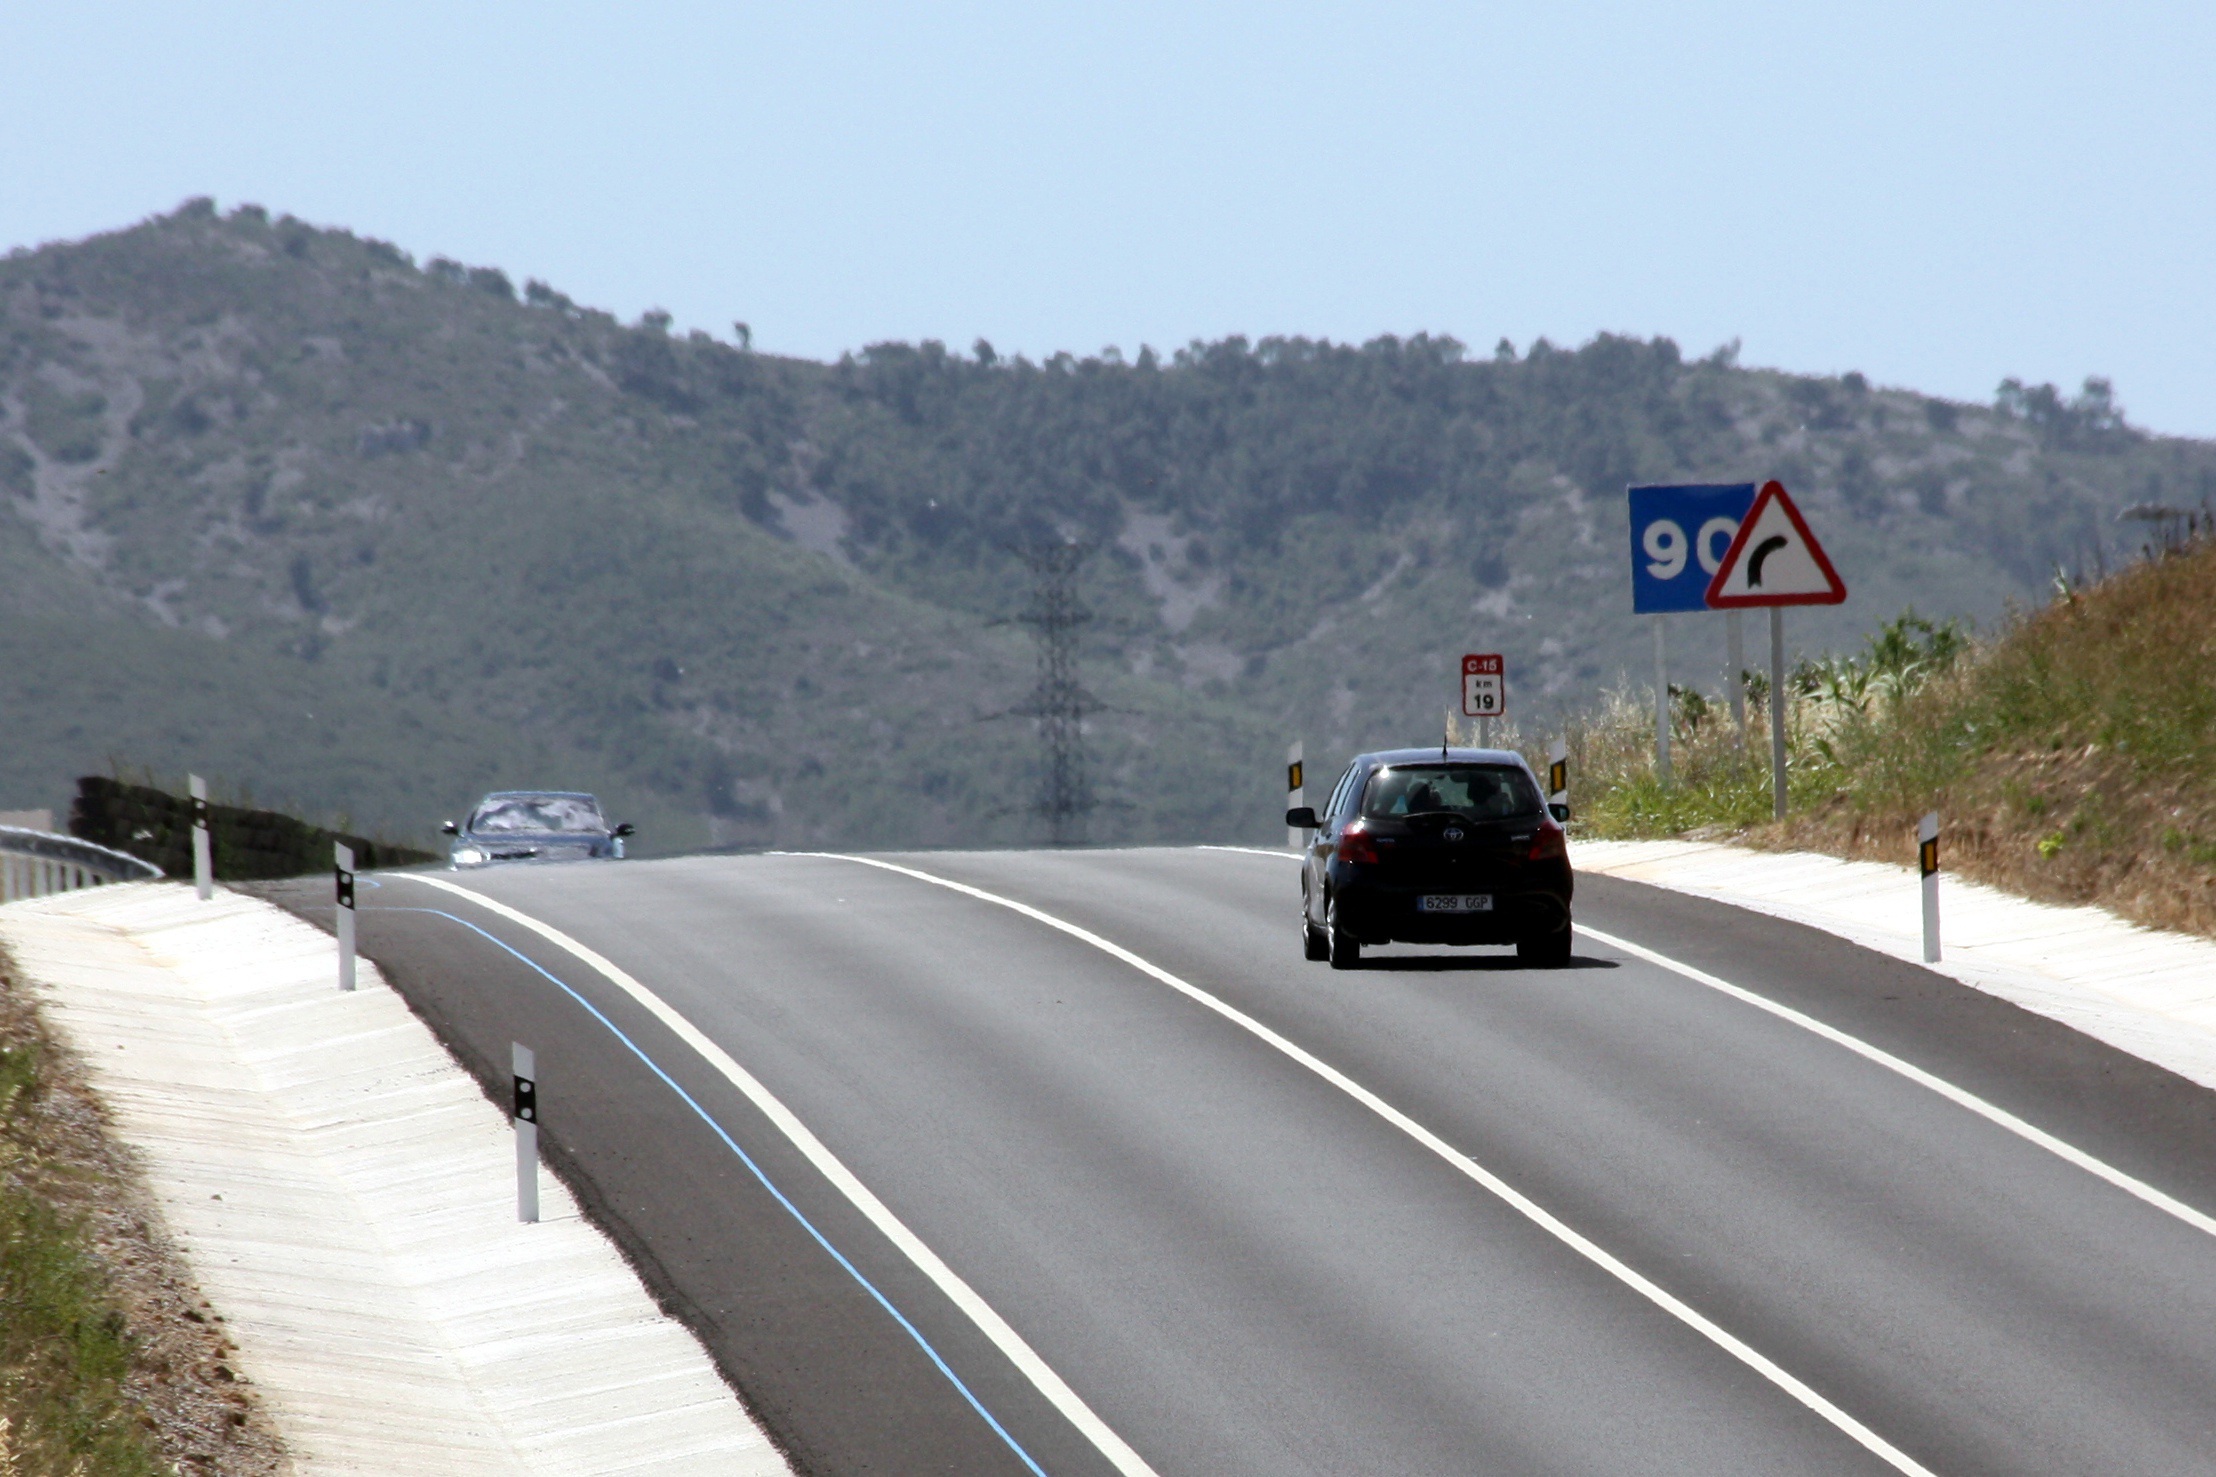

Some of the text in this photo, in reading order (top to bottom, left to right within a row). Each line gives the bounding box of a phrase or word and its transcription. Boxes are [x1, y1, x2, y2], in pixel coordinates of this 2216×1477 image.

[1642, 516, 1740, 580] 90
[1474, 694, 1494, 710] 19
[1426, 896, 1458, 909] 6299
